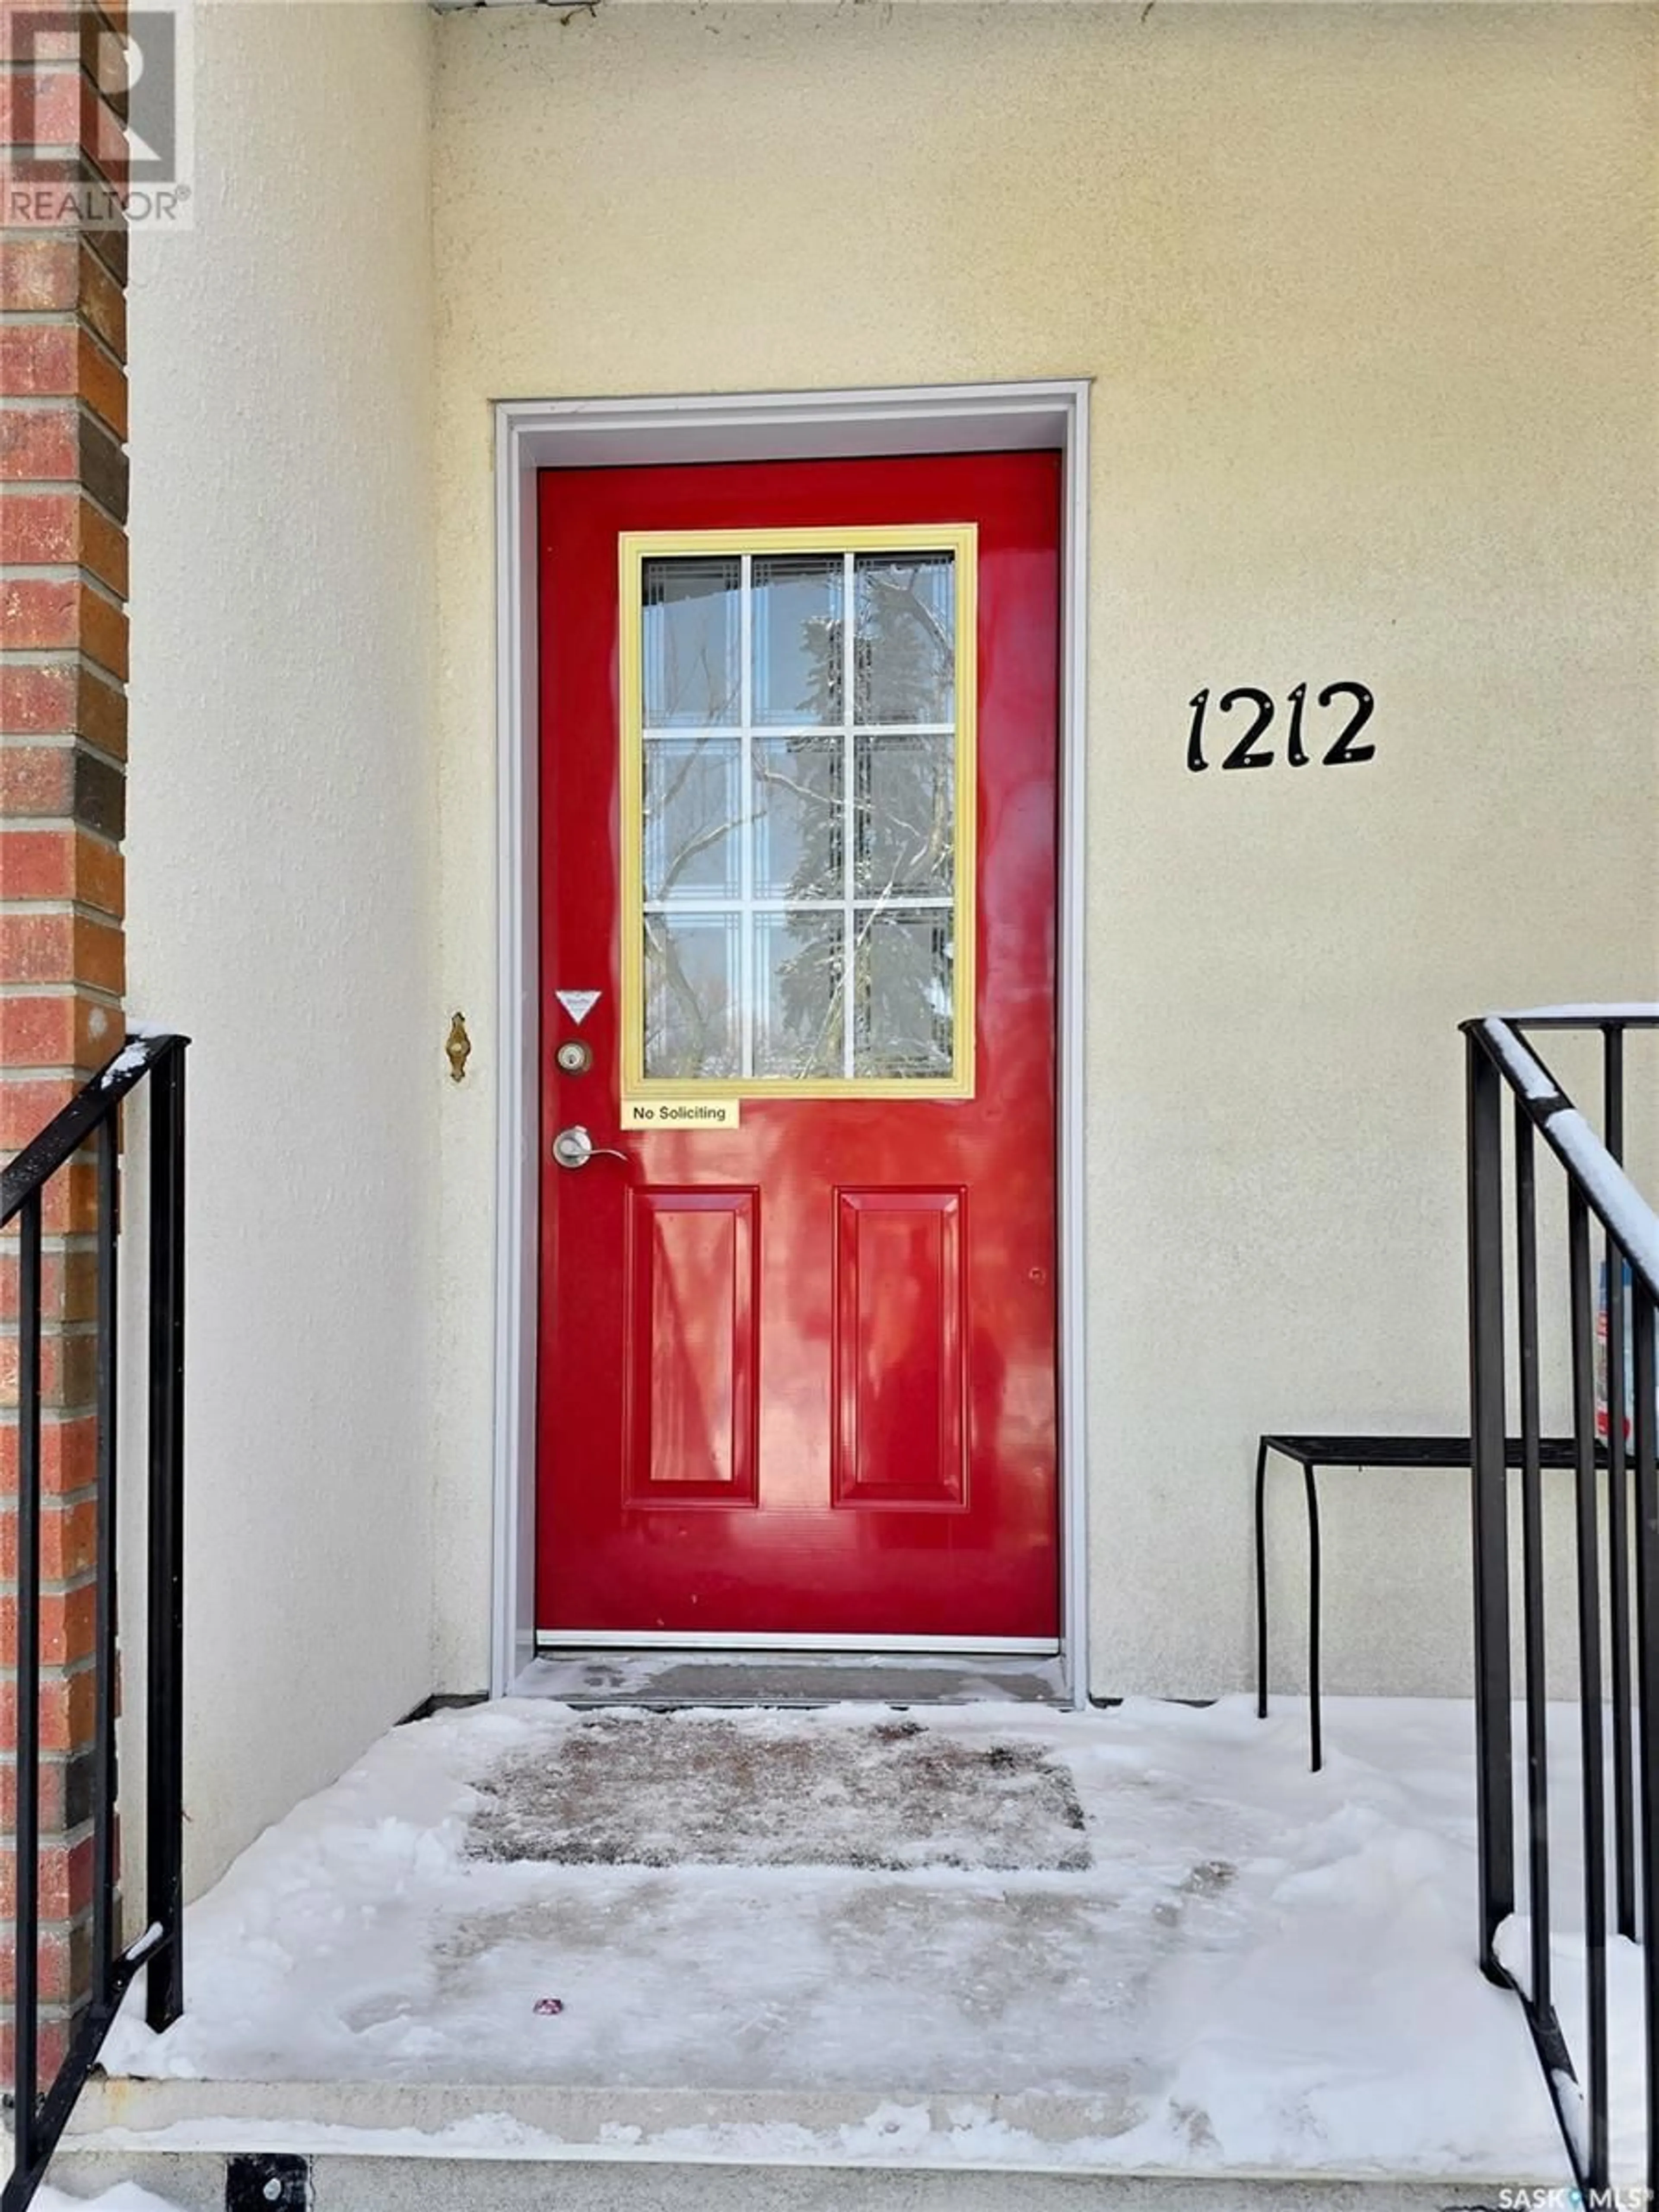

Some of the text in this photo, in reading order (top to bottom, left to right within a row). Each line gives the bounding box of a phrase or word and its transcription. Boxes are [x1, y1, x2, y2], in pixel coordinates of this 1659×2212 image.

[1187, 681, 1376, 772] 1212
[633, 1106, 726, 1121] No Soliciting
